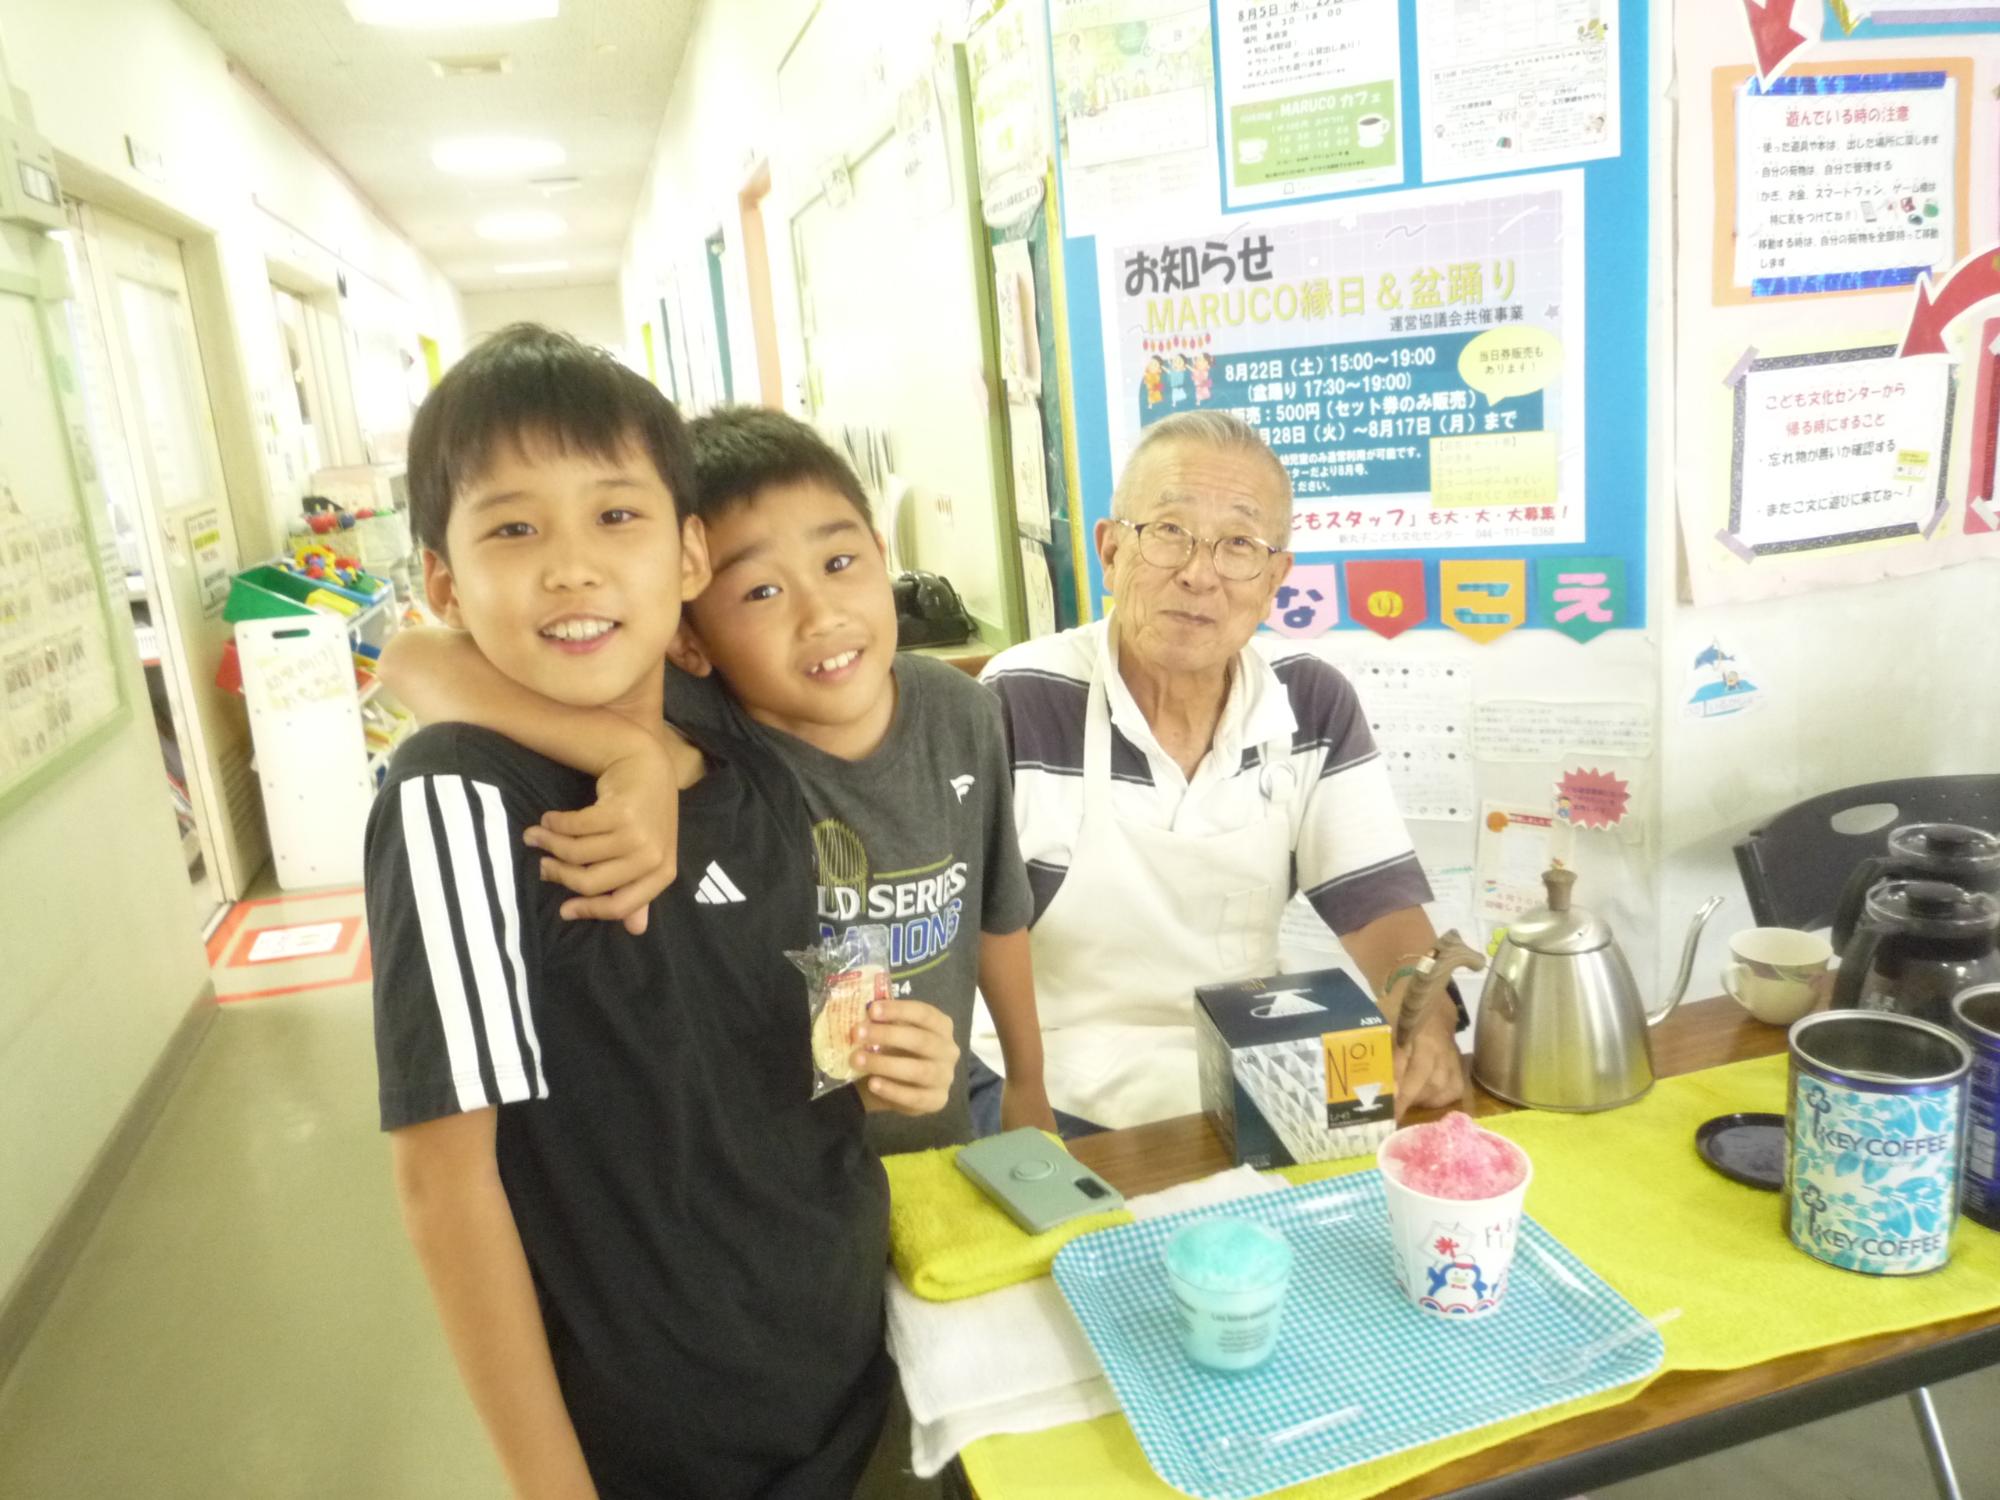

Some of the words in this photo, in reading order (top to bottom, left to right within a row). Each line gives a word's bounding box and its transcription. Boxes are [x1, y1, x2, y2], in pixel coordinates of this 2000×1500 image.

[1280, 95, 1336, 117] MARUCO
[1340, 90, 1381, 109] カフェ
[1785, 105, 1910, 128] 遊んでいる時の注意
[1123, 234, 1275, 297] お知らせ
[1760, 257, 1786, 270] します
[1389, 305, 1524, 333] 運営協議会共催事業
[1479, 345, 1544, 363] 当日券販売も
[1765, 382, 1906, 410] こども文化センターから
[1786, 413, 1886, 437] 帰る時にすること
[868, 862, 968, 920] SERIES
[1820, 1129, 1865, 1154] KEY
[1865, 1134, 1949, 1157] COFFEE
[1815, 1227, 1862, 1251] KEY
[1861, 1233, 1942, 1257] COFFEE
